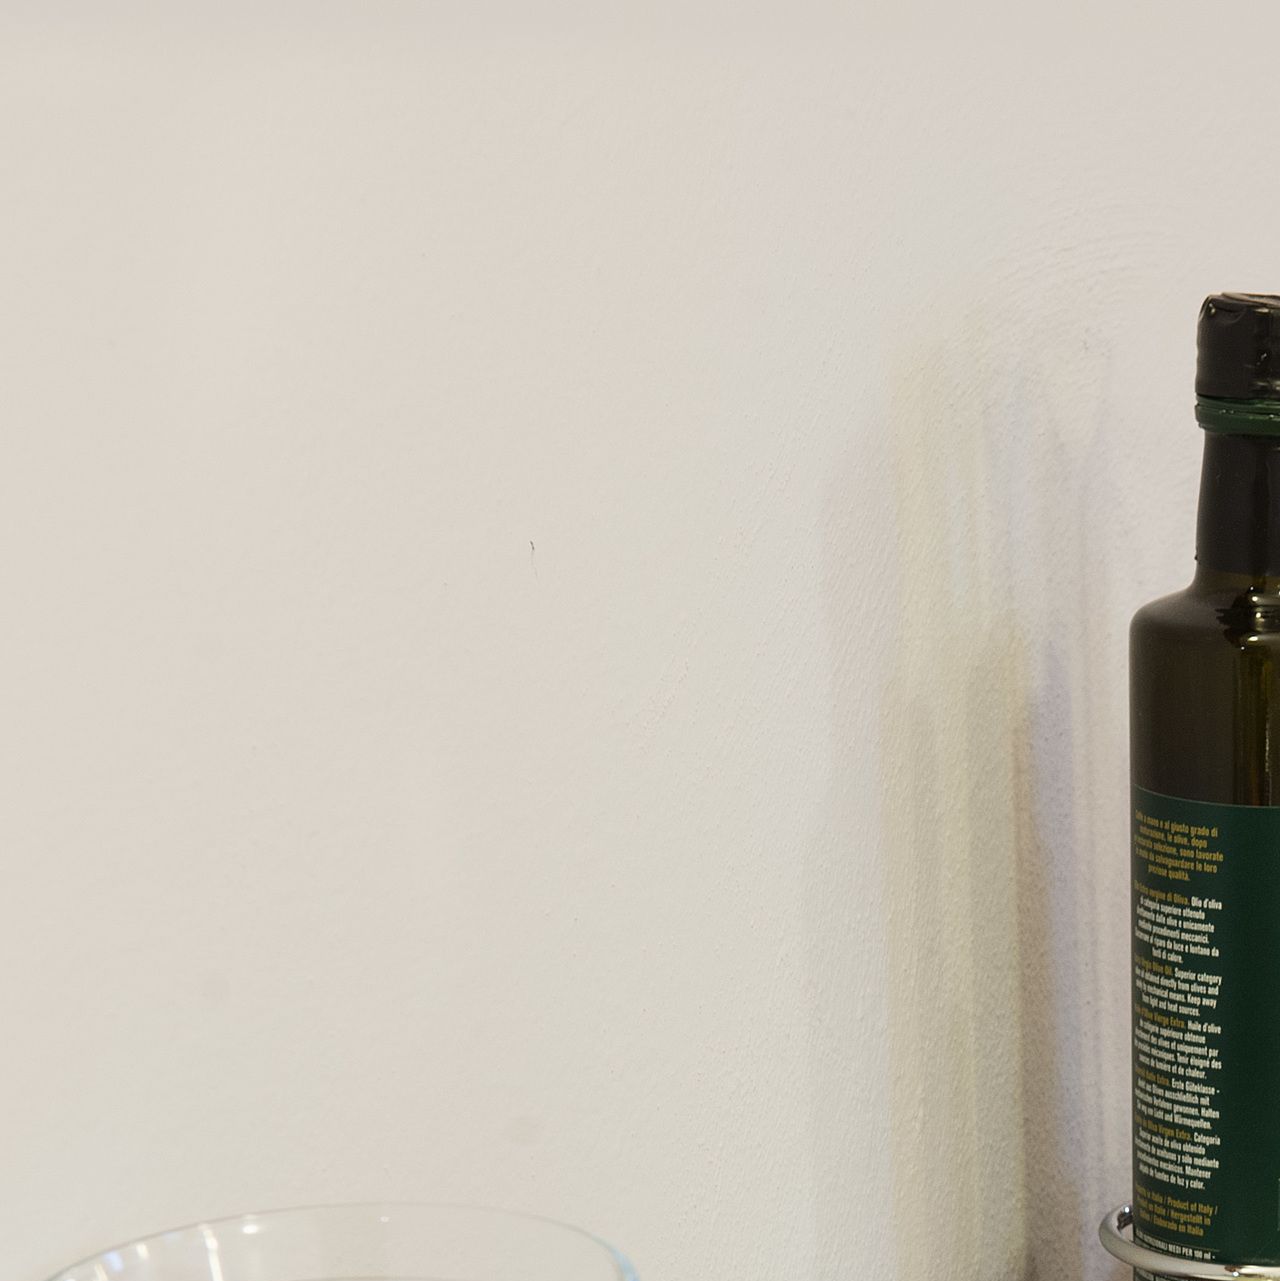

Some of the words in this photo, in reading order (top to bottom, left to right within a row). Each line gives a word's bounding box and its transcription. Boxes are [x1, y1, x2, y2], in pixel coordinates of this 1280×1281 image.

[1211, 828, 1218, 837] di
[1191, 838, 1207, 848] dopo
[1196, 850, 1224, 861] lavorate
[1191, 897, 1202, 907] Olio
[1203, 899, 1222, 909] d'oliva
[1190, 944, 1210, 956] lontano
[1212, 947, 1219, 957] da
[1175, 967, 1196, 980] Superior
[1197, 972, 1222, 986] category
[1208, 986, 1219, 995] and
[1187, 994, 1201, 1006] Keep
[1202, 999, 1217, 1009] away
[1188, 1020, 1201, 1032] Huile
[1203, 1023, 1221, 1034] d'olive
[1209, 1049, 1219, 1058] par
[1211, 1060, 1222, 1069] des
[1186, 1081, 1215, 1095] Güteklasse
[1190, 1180, 1206, 1190] calor.
[1182, 1247, 1193, 1257] PER
